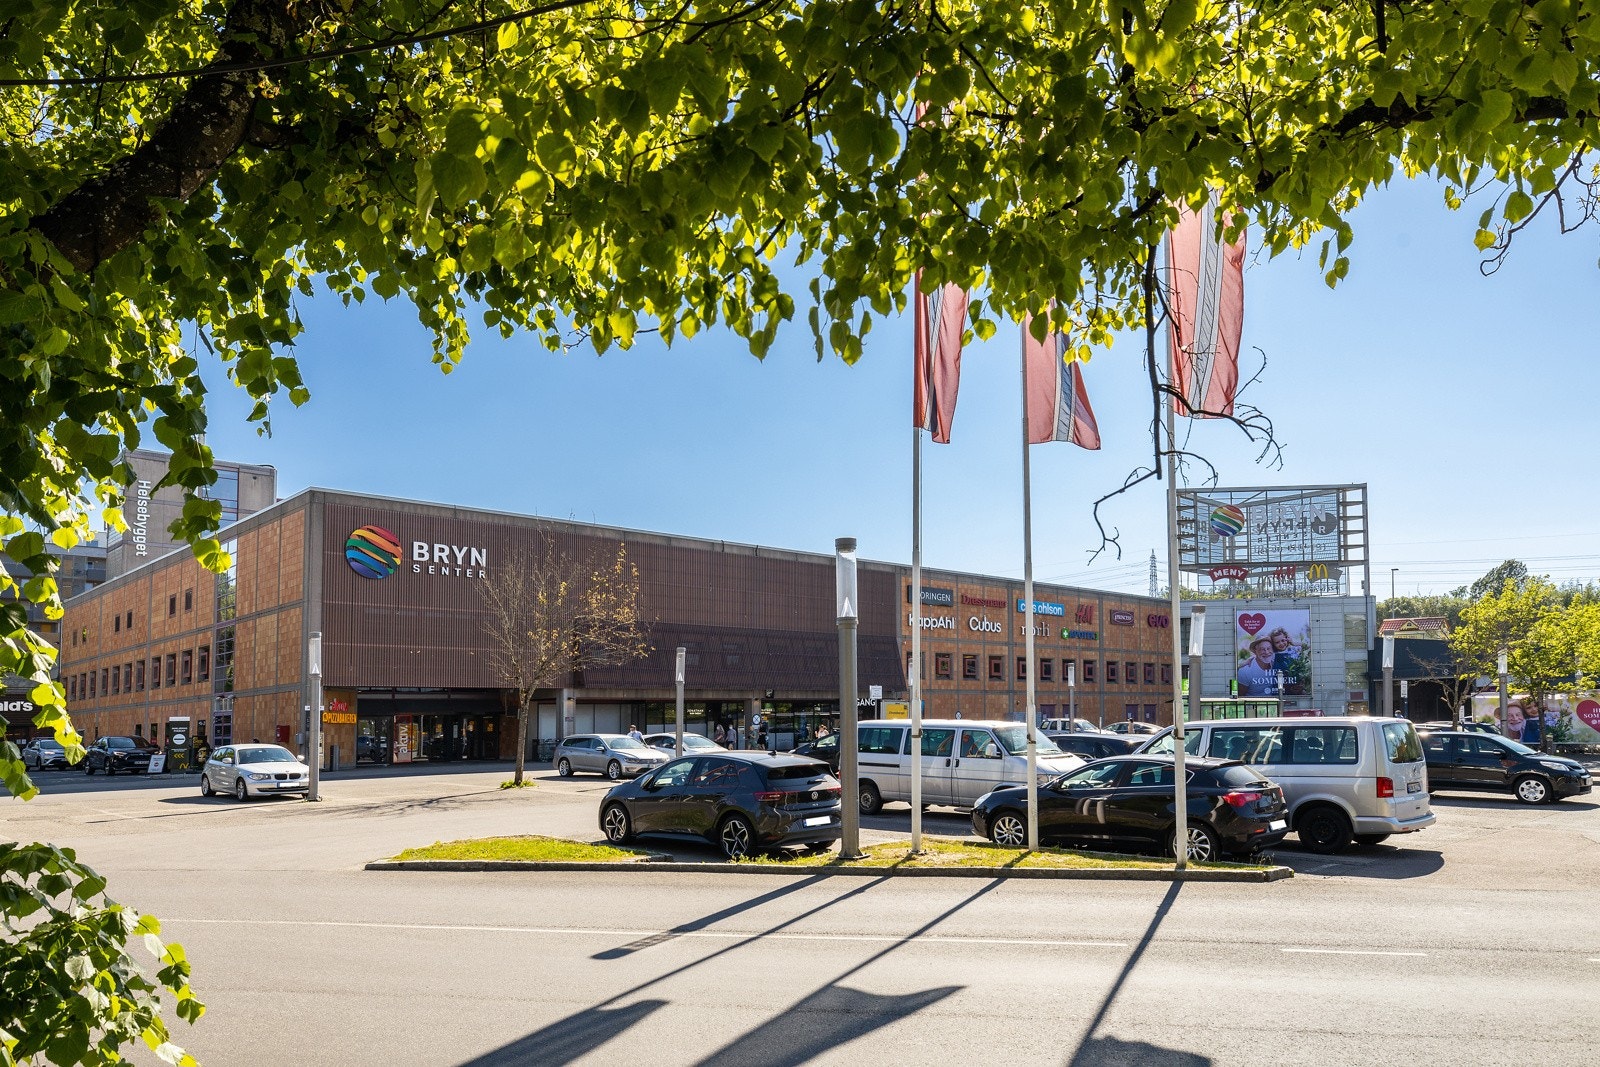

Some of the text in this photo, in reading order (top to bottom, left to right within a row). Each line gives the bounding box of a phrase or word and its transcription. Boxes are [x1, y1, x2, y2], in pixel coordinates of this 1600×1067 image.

[132, 480, 151, 557] Helsebygget
[1252, 504, 1326, 523] BRYN
[412, 541, 487, 567] BRYN
[412, 564, 486, 579] SENTER
[1213, 568, 1244, 578] MENY
[919, 591, 951, 602] ORINGEN
[1020, 602, 1063, 615] cs ohlson
[969, 615, 1002, 633] Cubus
